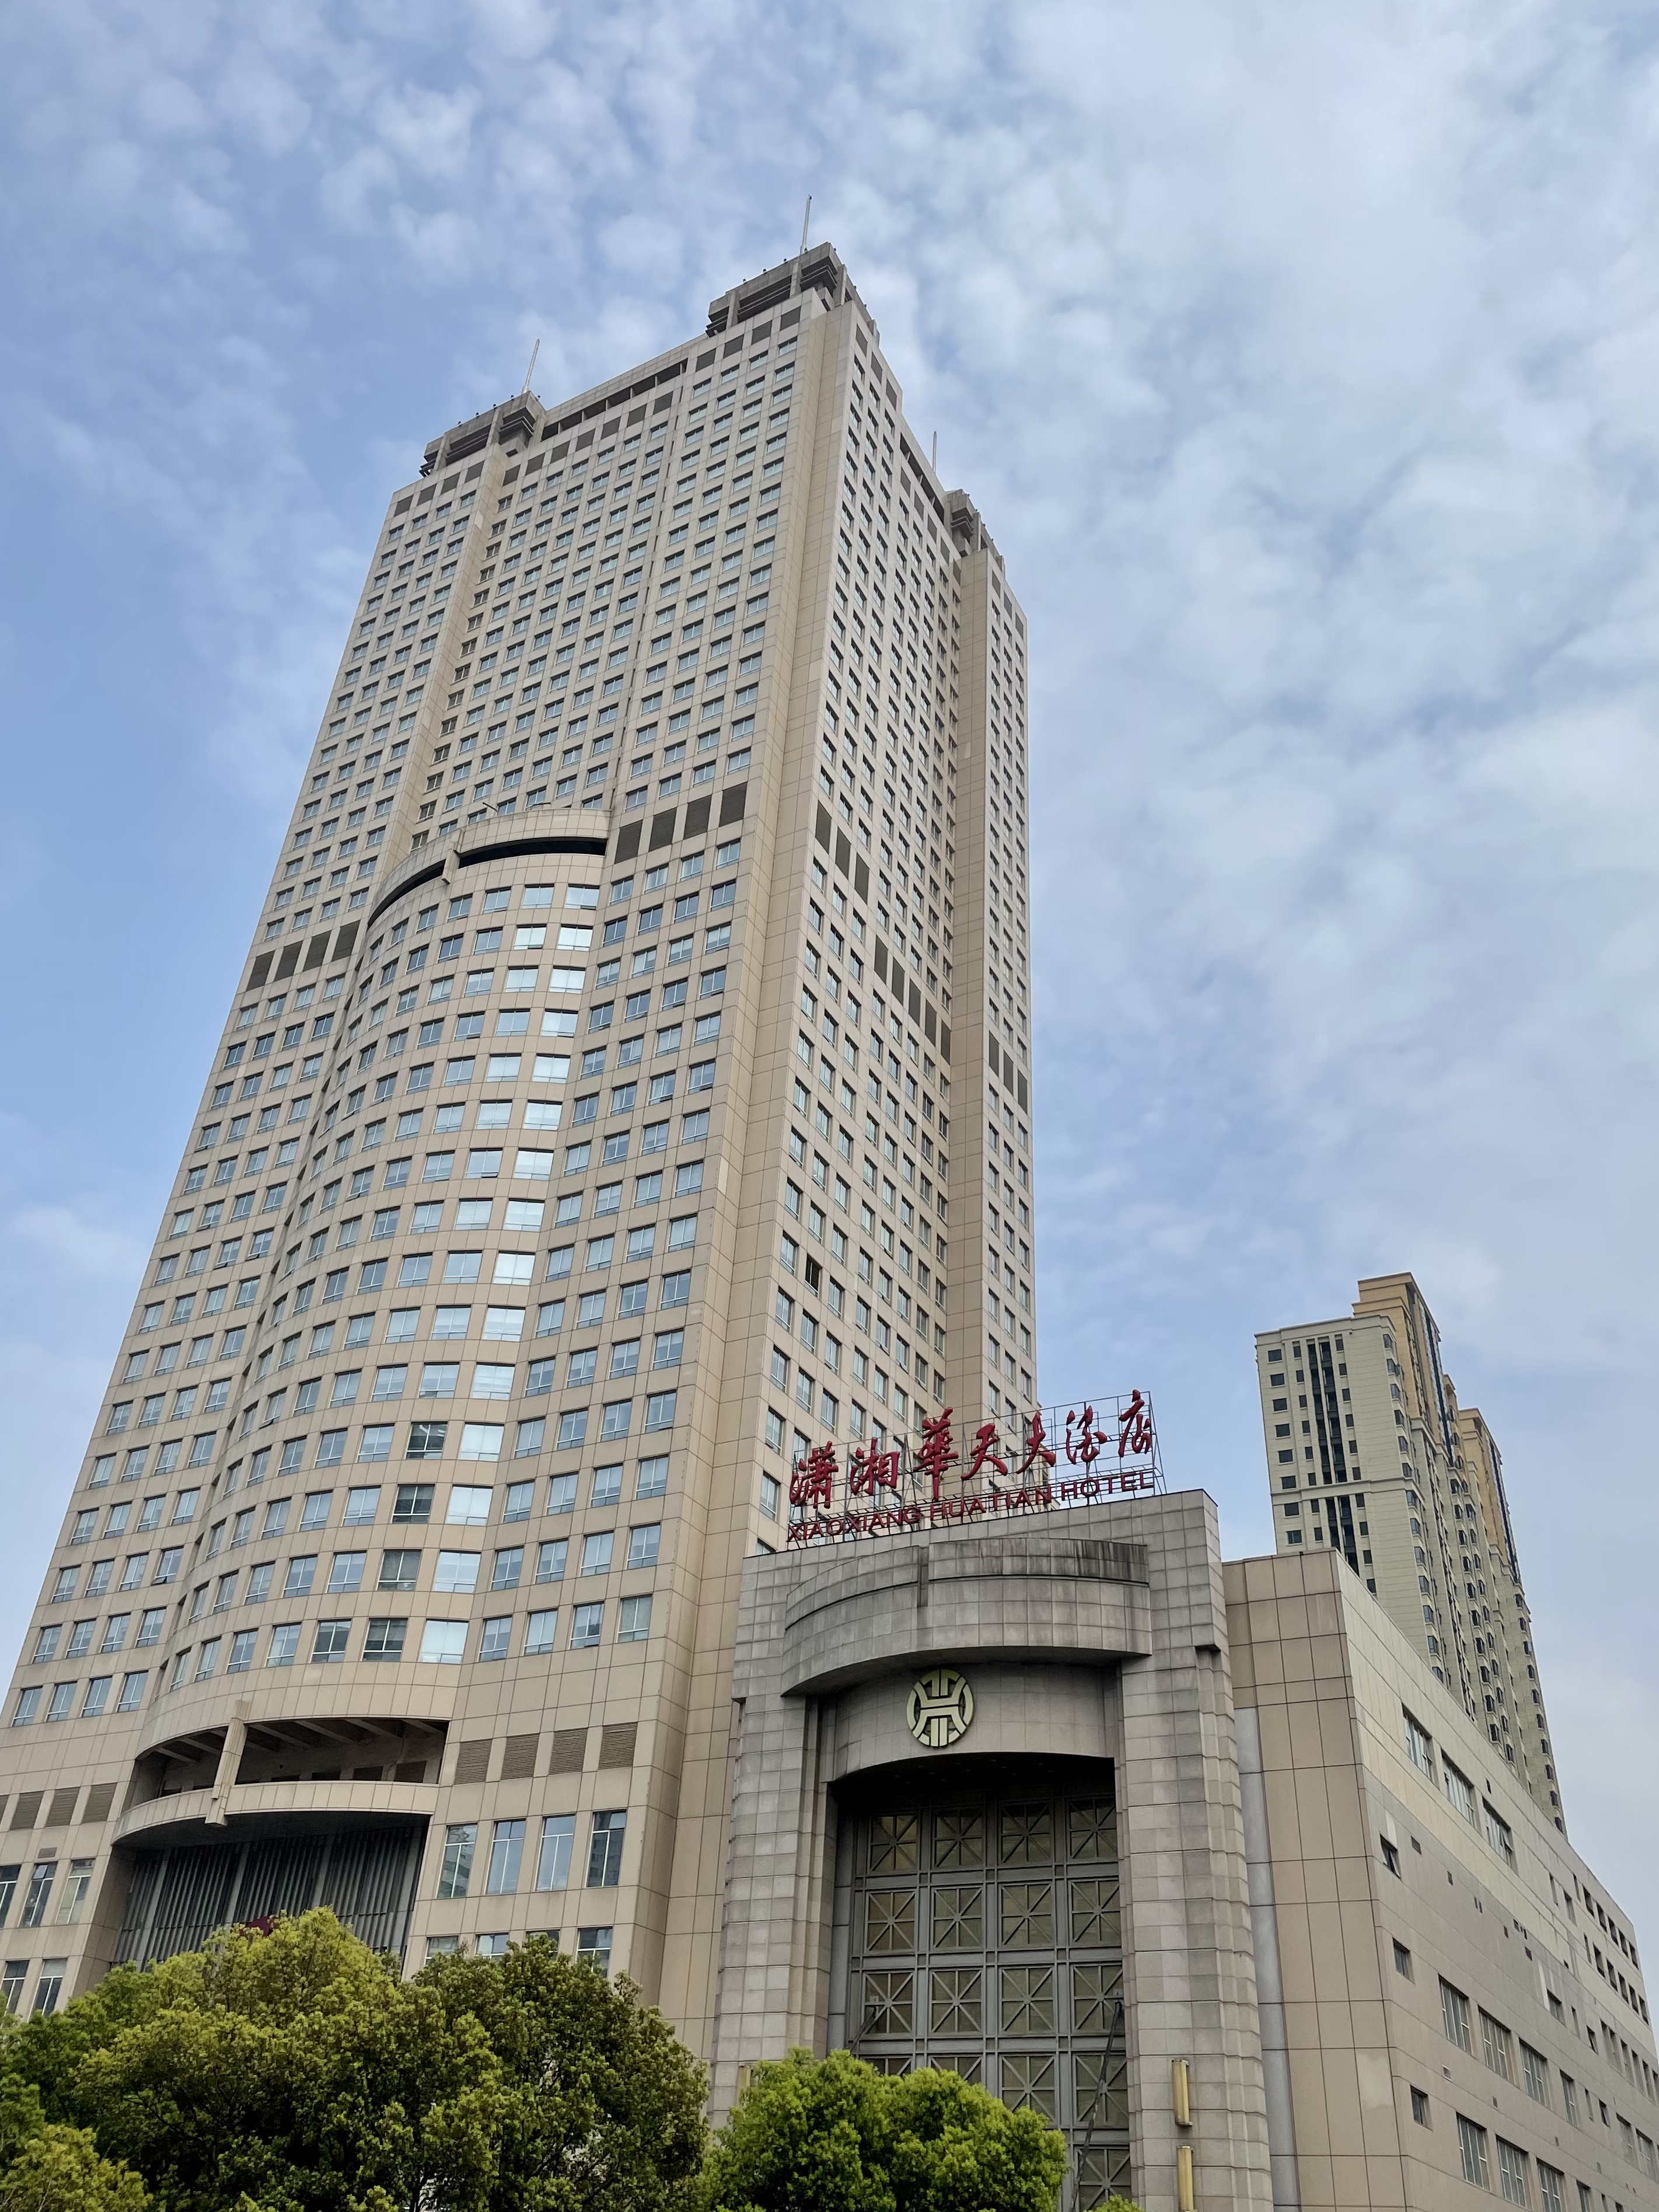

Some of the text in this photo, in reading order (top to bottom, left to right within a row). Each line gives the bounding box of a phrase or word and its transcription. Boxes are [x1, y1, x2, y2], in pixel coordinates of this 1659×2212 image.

[787, 1471, 1154, 1542] XIAOXIANG HUATIAN HOTEL
